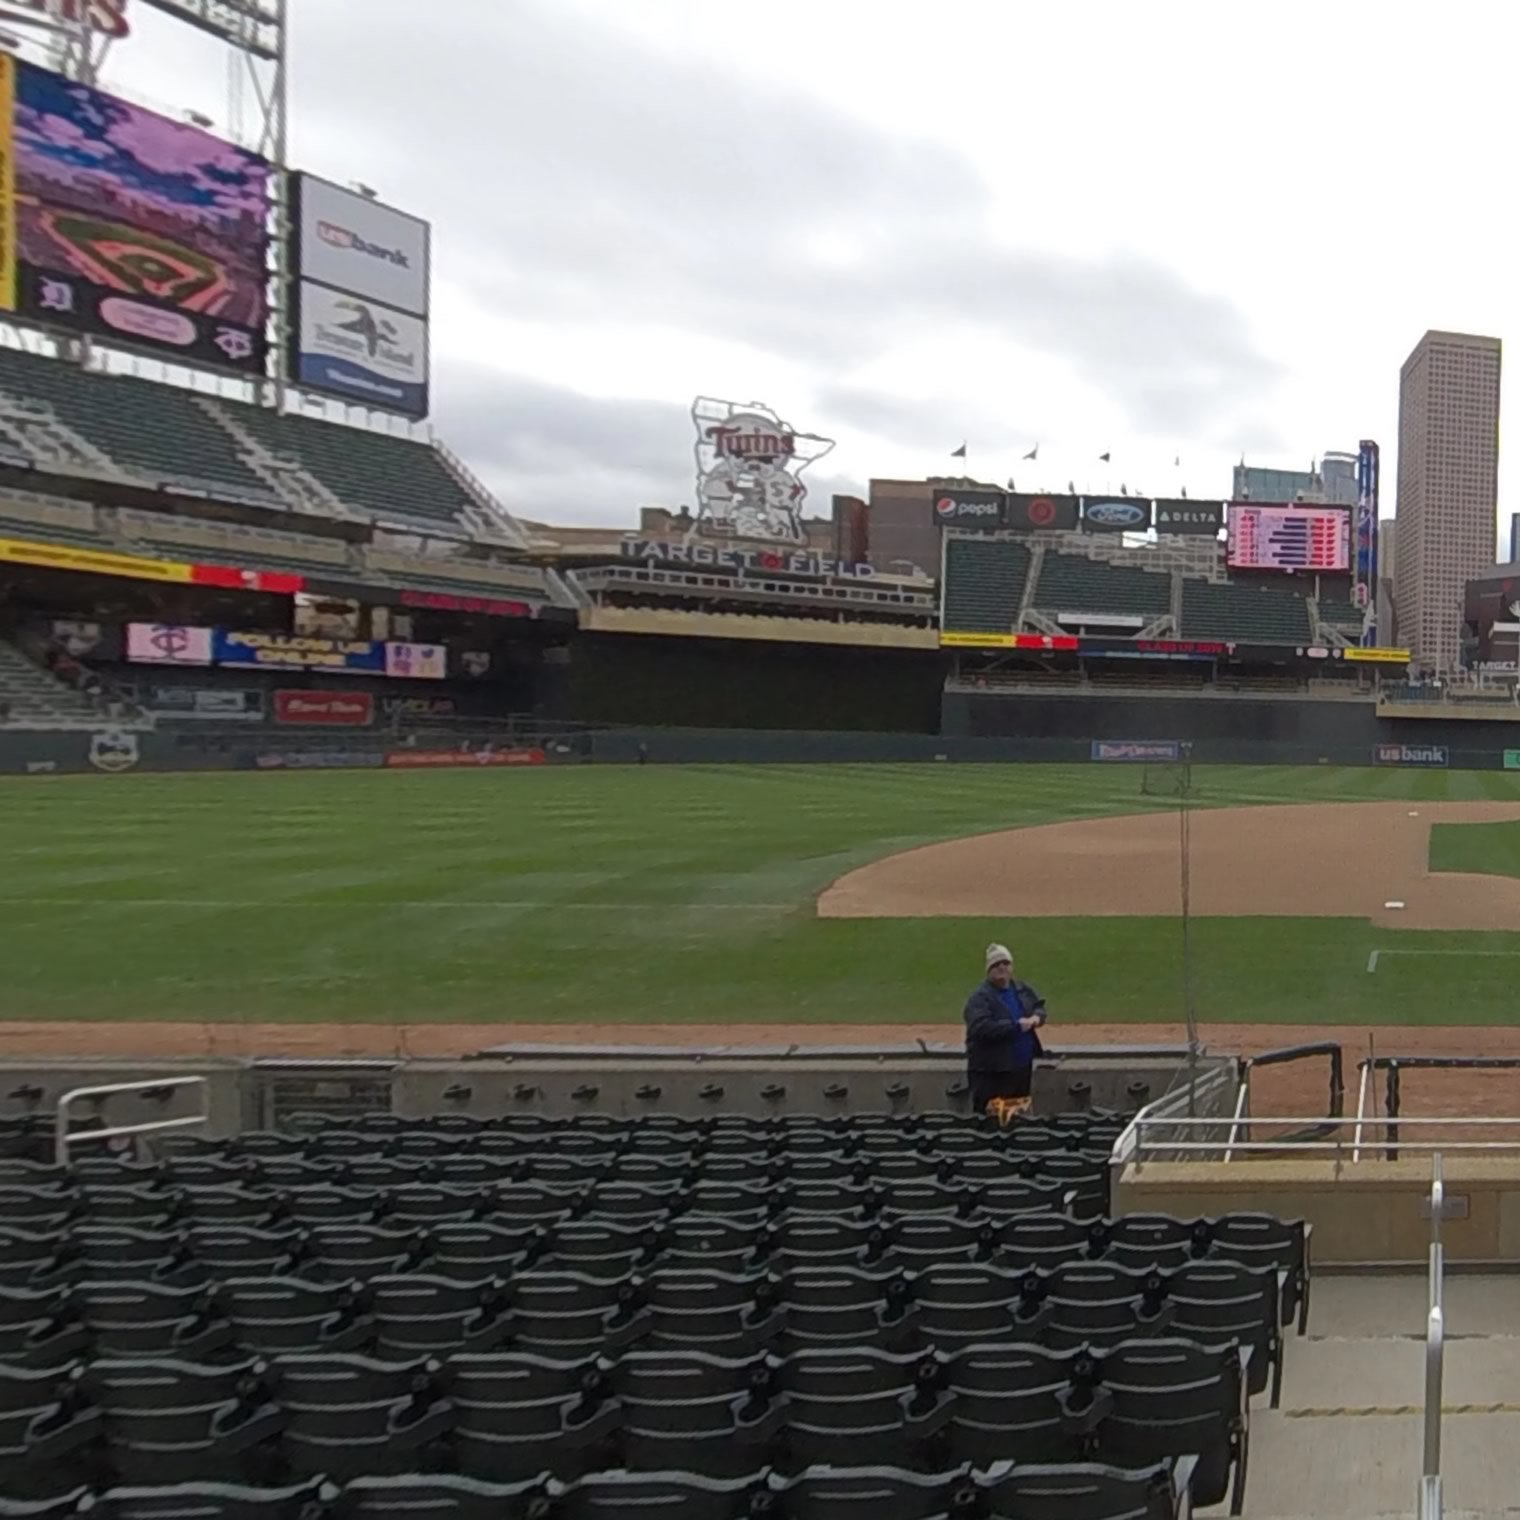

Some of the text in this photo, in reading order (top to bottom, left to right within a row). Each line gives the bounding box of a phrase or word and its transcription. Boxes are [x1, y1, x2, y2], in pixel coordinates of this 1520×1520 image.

[704, 426, 795, 463] Twins
[957, 497, 998, 516] pepsi
[1097, 503, 1136, 521] Ford
[1172, 511, 1217, 523] DELTA
[621, 540, 876, 578] TARGET FIELD
[1472, 661, 1516, 671] TARGET
